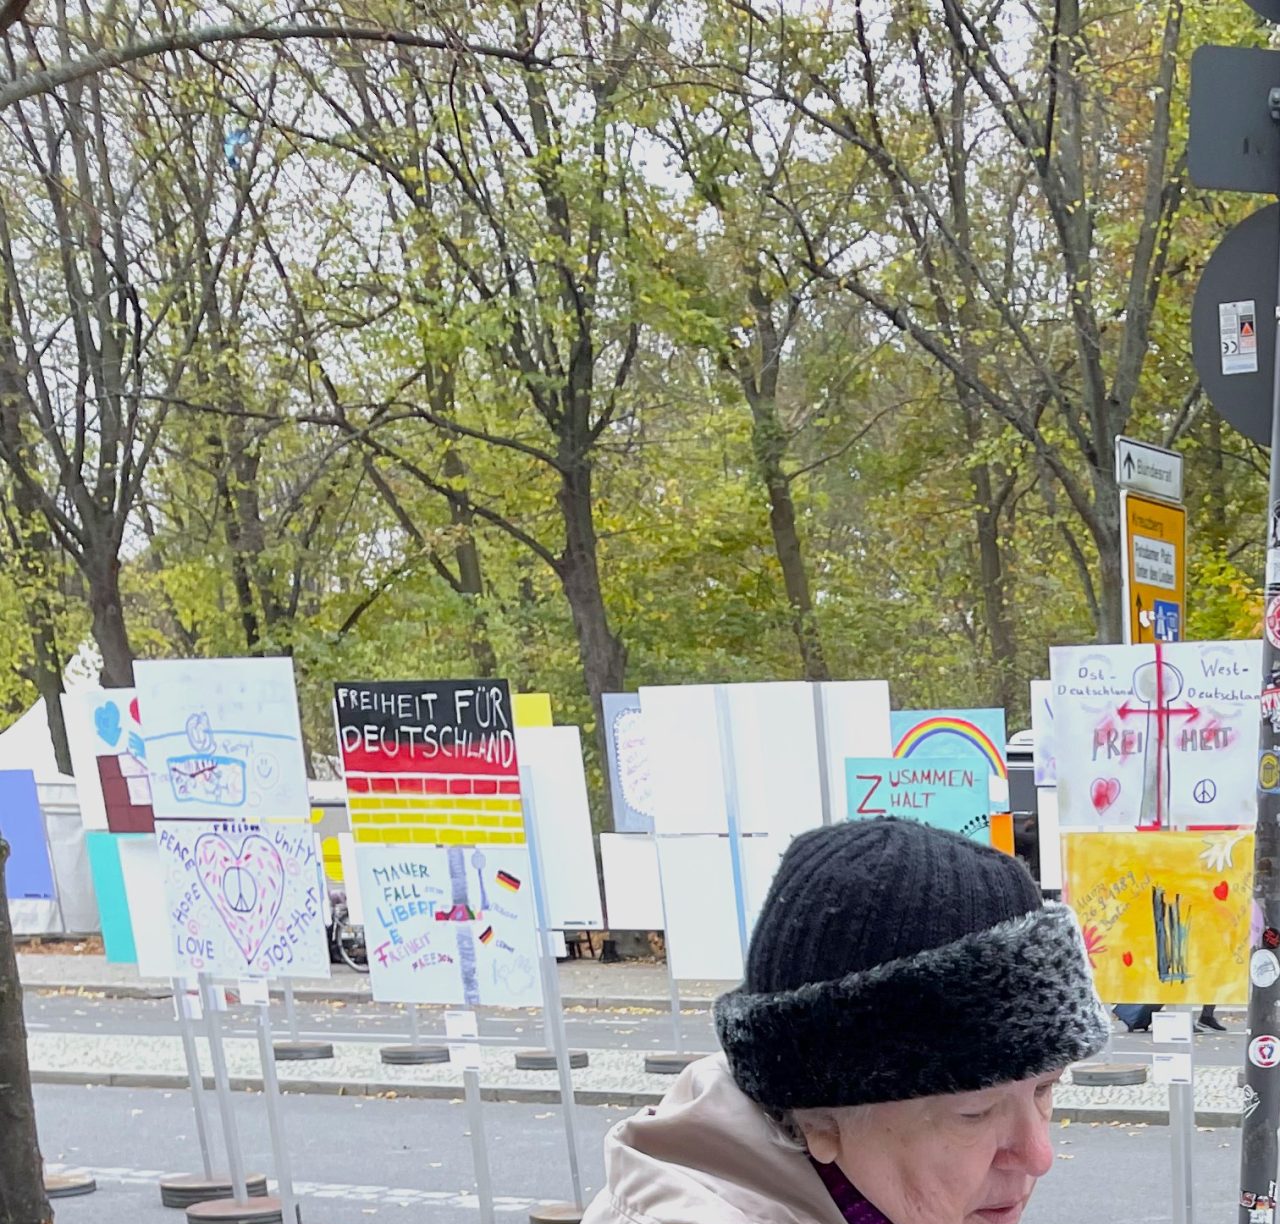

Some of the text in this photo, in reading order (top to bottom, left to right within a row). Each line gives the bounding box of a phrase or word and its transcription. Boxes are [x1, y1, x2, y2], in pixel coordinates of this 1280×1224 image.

[1200, 658, 1249, 678] West-
[1188, 688, 1260, 700] Deutschlan
[338, 686, 508, 729] FREIHEIT FÜR
[341, 724, 514, 768] DEUTSCHLAND
[1092, 726, 1232, 762] FREI HEIT
[856, 768, 982, 814] ZUSAMMEN-
[890, 792, 936, 808] HALT
[384, 884, 421, 902] FALL
[177, 935, 214, 960] LOVE
